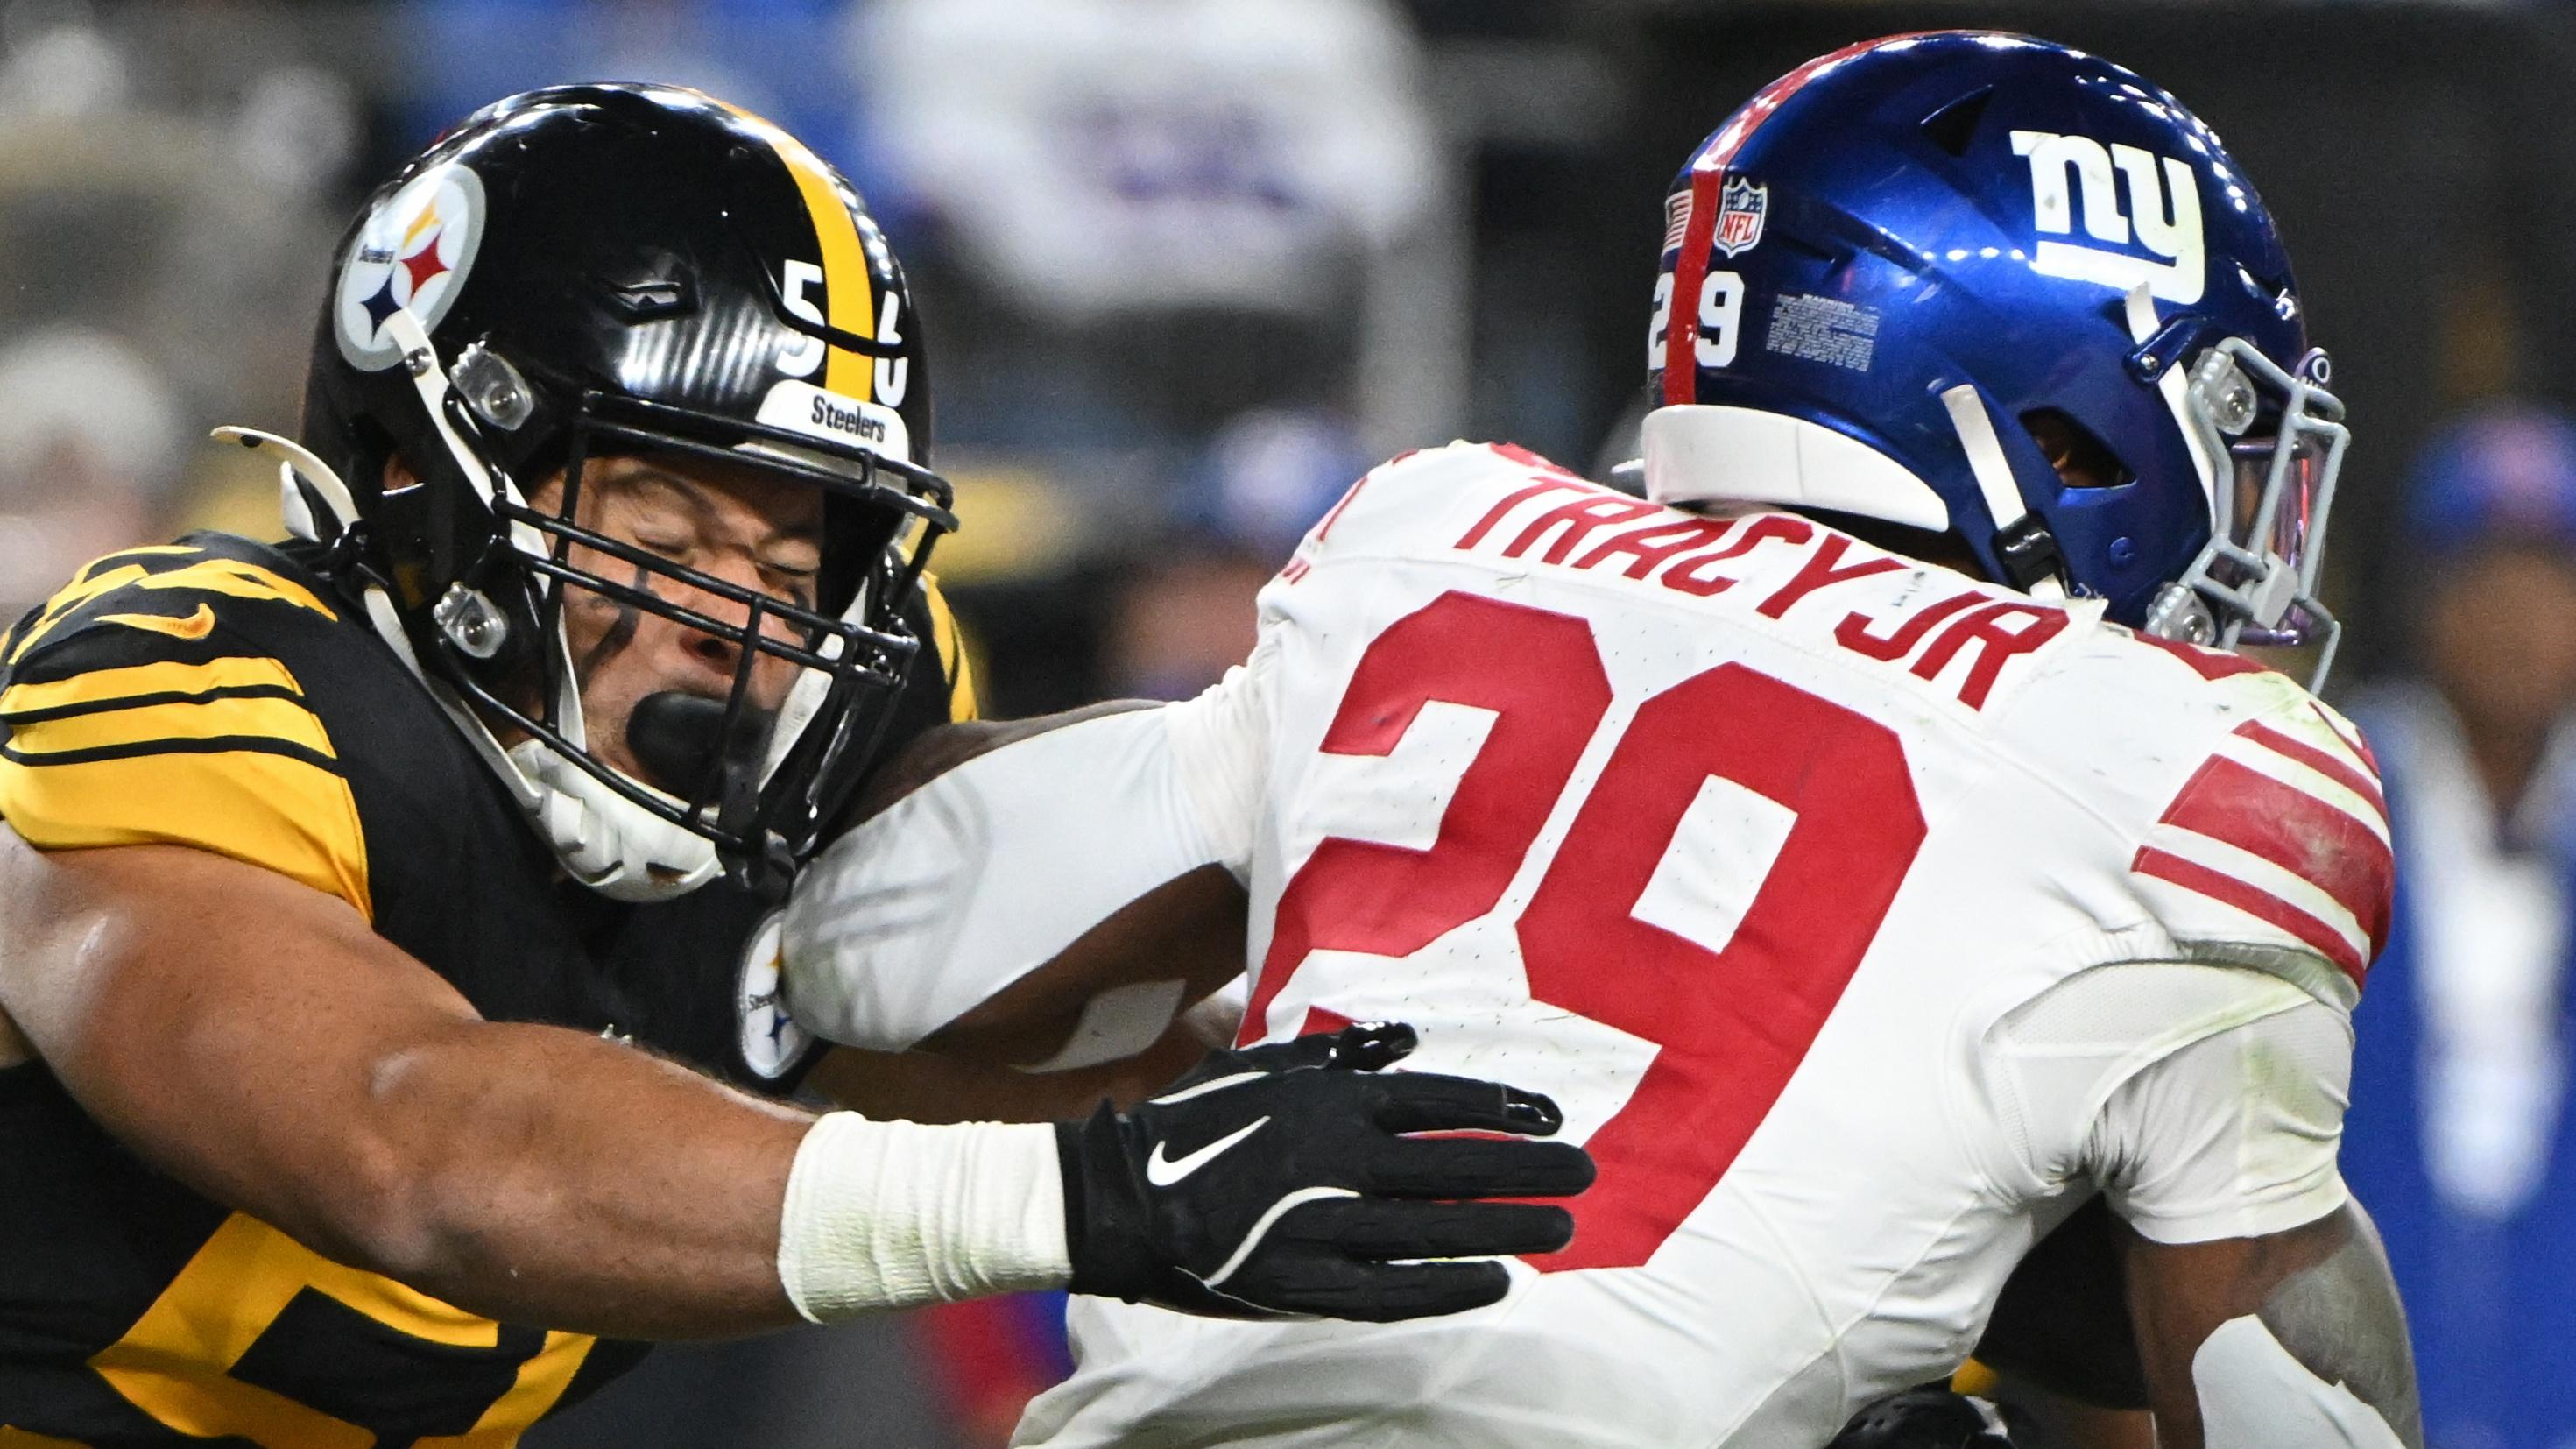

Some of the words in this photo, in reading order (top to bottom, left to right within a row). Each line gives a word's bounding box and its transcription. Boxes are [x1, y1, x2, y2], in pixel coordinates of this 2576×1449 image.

[1719, 213, 1753, 243] NFL
[811, 394, 886, 443] Steelers
[1454, 476, 1911, 620] TRACY
[1834, 590, 2071, 711] JR
[1236, 590, 1928, 1273] 29
